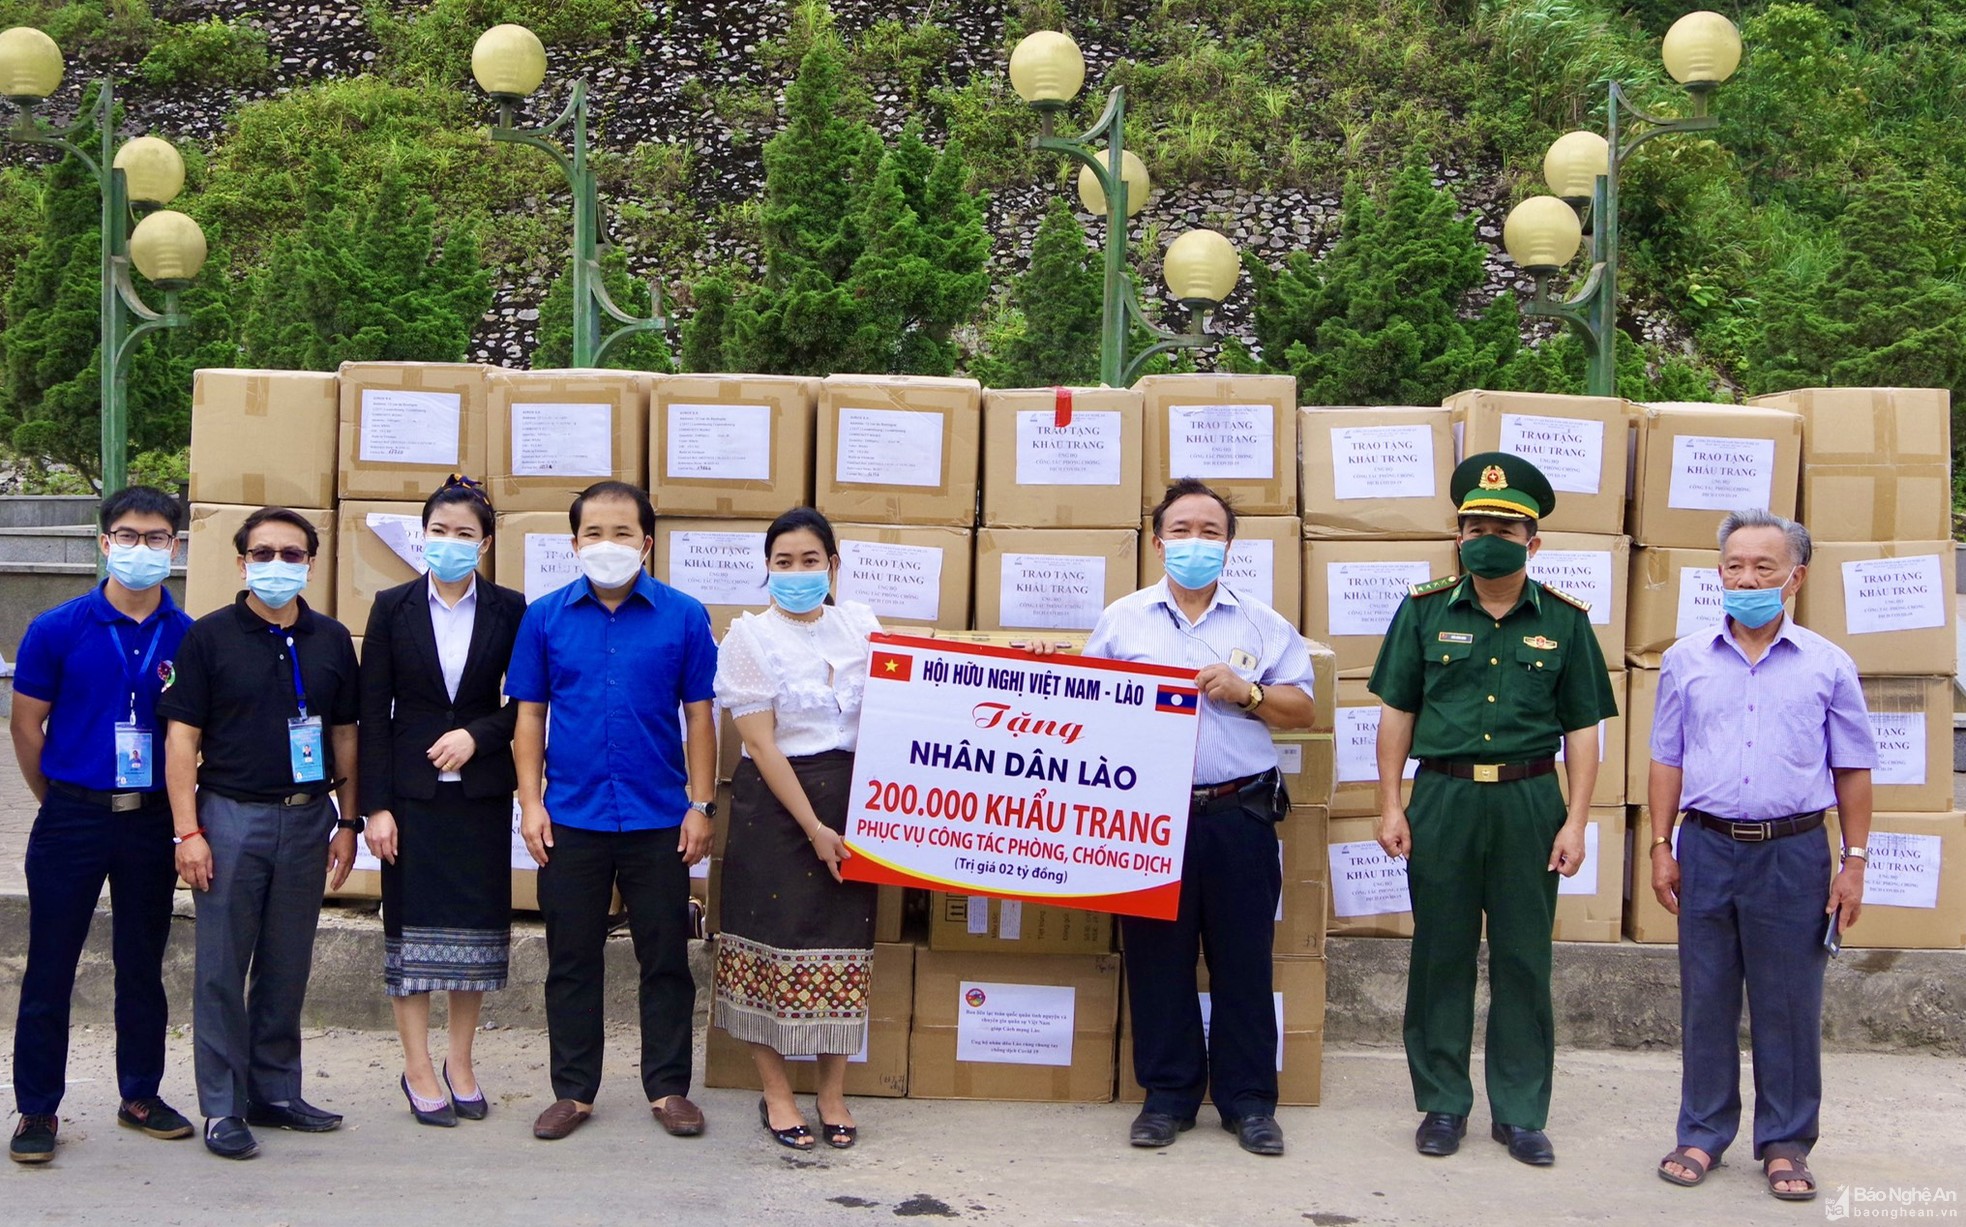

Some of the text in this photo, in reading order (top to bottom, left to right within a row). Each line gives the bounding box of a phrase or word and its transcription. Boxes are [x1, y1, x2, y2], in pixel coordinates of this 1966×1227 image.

[1190, 421, 1220, 429] TRAO
[1037, 427, 1067, 435] TRAO
[1521, 430, 1550, 439] TRAO
[1219, 435, 1257, 443] TRANG
[1067, 441, 1104, 449] TRANG
[1351, 442, 1380, 450] TRAO
[1549, 447, 1585, 457] TRANG
[1693, 452, 1721, 461] TRAO
[1381, 455, 1417, 463] TRANG
[1720, 467, 1756, 477] TRANG
[689, 545, 717, 554] TRAO
[859, 557, 888, 567] TRAO
[1230, 555, 1252, 565] ẶNG
[718, 561, 753, 569] TRANG
[1021, 570, 1051, 578] TRAO
[1530, 566, 1559, 574] TRAO
[887, 574, 924, 584] TRANG
[1348, 578, 1377, 586] TRAO
[1862, 574, 1891, 583] TRAO
[1051, 585, 1088, 594] TRANG
[1560, 581, 1595, 589] TRANG
[1891, 585, 1927, 595] TRANG
[1377, 592, 1406, 600] TRAN
[923, 657, 949, 687] HỘI
[953, 661, 984, 688] HỮU
[987, 667, 1025, 697] NGHỊ
[1029, 670, 1061, 700] VIỆT
[1064, 676, 1101, 701] NAM
[1115, 679, 1144, 706] LÀO
[972, 702, 1085, 744] Tặng
[1355, 723, 1379, 731] TRA
[909, 739, 1137, 791] NHÂN DÂN LÀO
[865, 779, 1172, 847] 200.000 KHẨU TRANG
[857, 819, 1172, 877] PHỤC VỤ CÔNG TÁC PHÒNG, CHỐNG DỊCH
[1868, 847, 1890, 856] RAO
[1349, 856, 1379, 866] TRAO
[955, 857, 1068, 884] (Trị giá 02 tỷ đồng)
[1888, 863, 1924, 872] TRANG
[1381, 868, 1408, 877] TRAN
